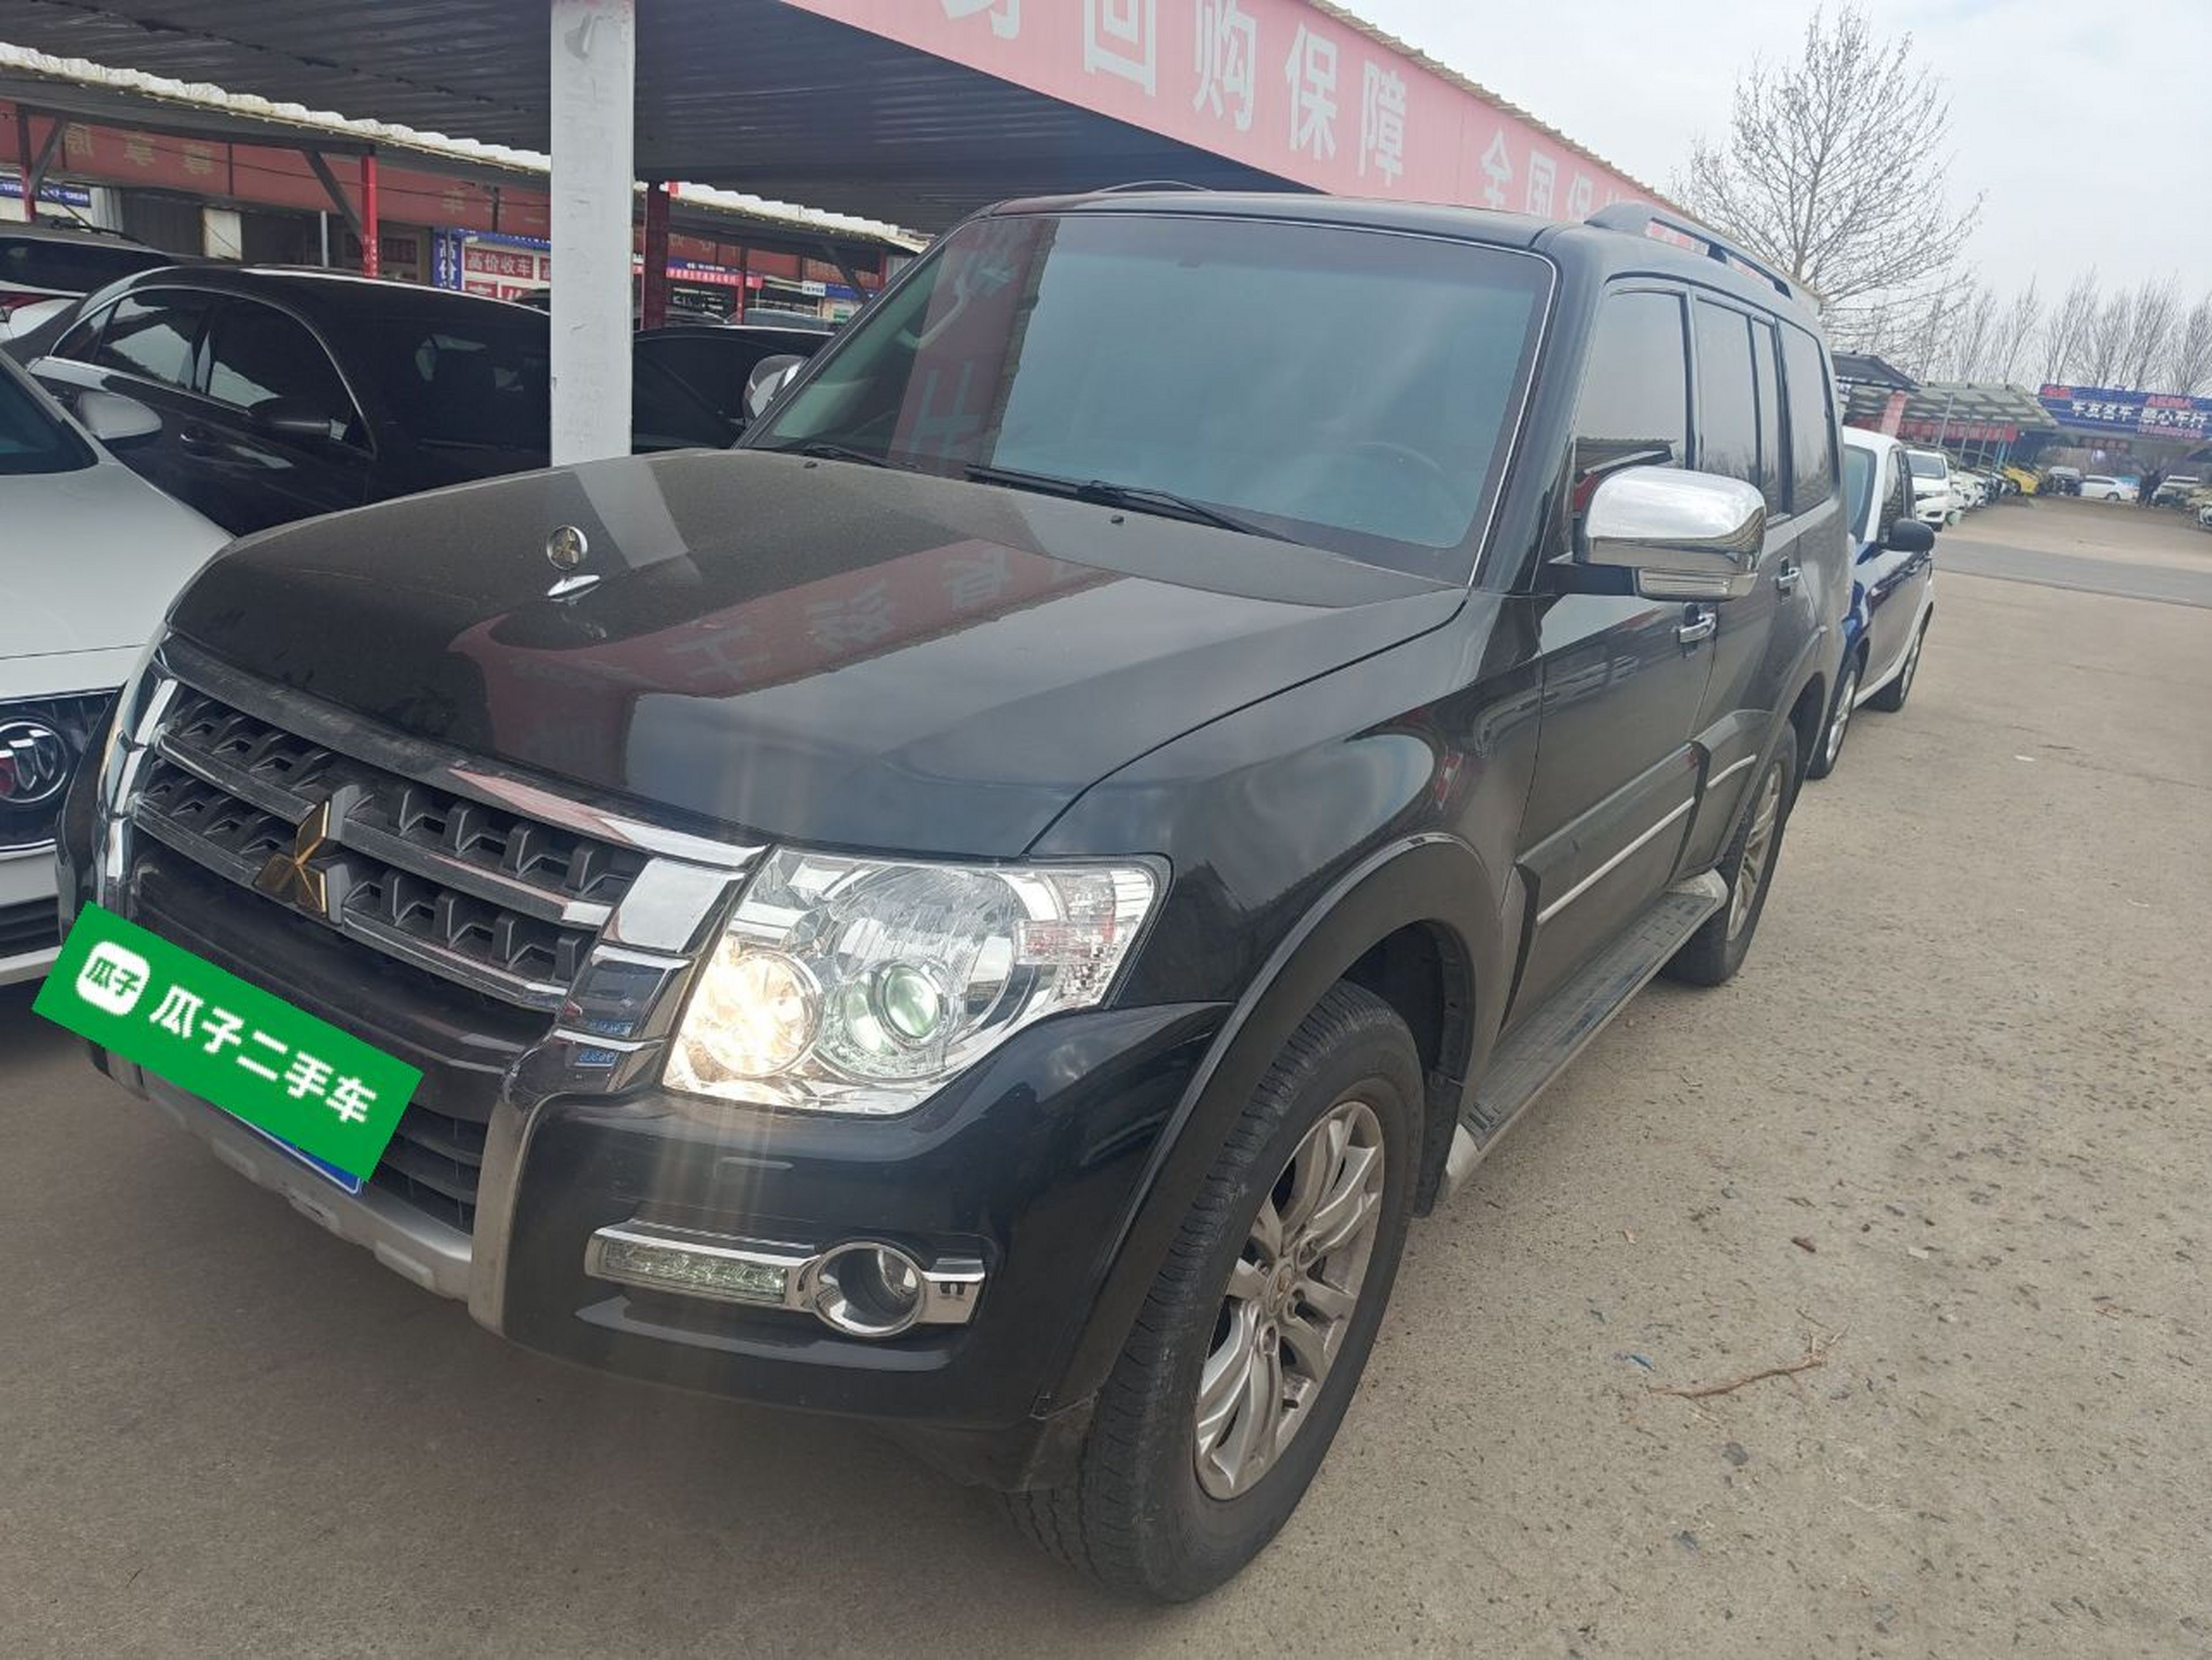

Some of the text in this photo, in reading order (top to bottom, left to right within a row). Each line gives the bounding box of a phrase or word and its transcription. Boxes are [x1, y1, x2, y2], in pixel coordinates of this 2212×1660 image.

[1480, 126, 1622, 222] 全国保
[468, 251, 531, 276] 高价收车
